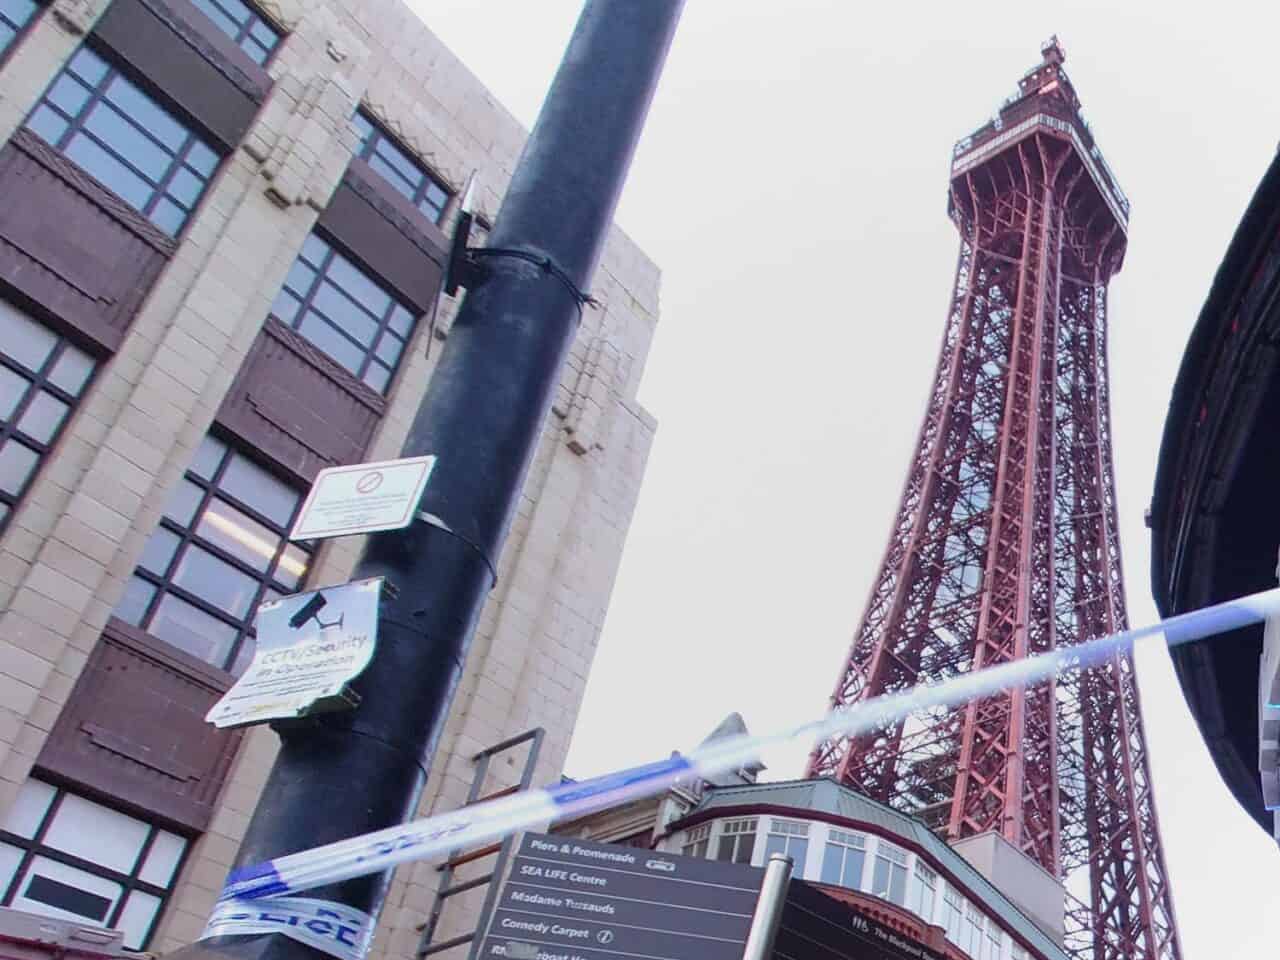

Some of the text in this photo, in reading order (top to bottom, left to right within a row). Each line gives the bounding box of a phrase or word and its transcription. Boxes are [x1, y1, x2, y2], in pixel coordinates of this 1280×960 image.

[531, 840, 636, 863] Piers & Promenade
[520, 865, 607, 887] SEA LIFE Centre
[511, 891, 615, 915] Madame Tussauds
[502, 918, 590, 942] Comedy Carpet
